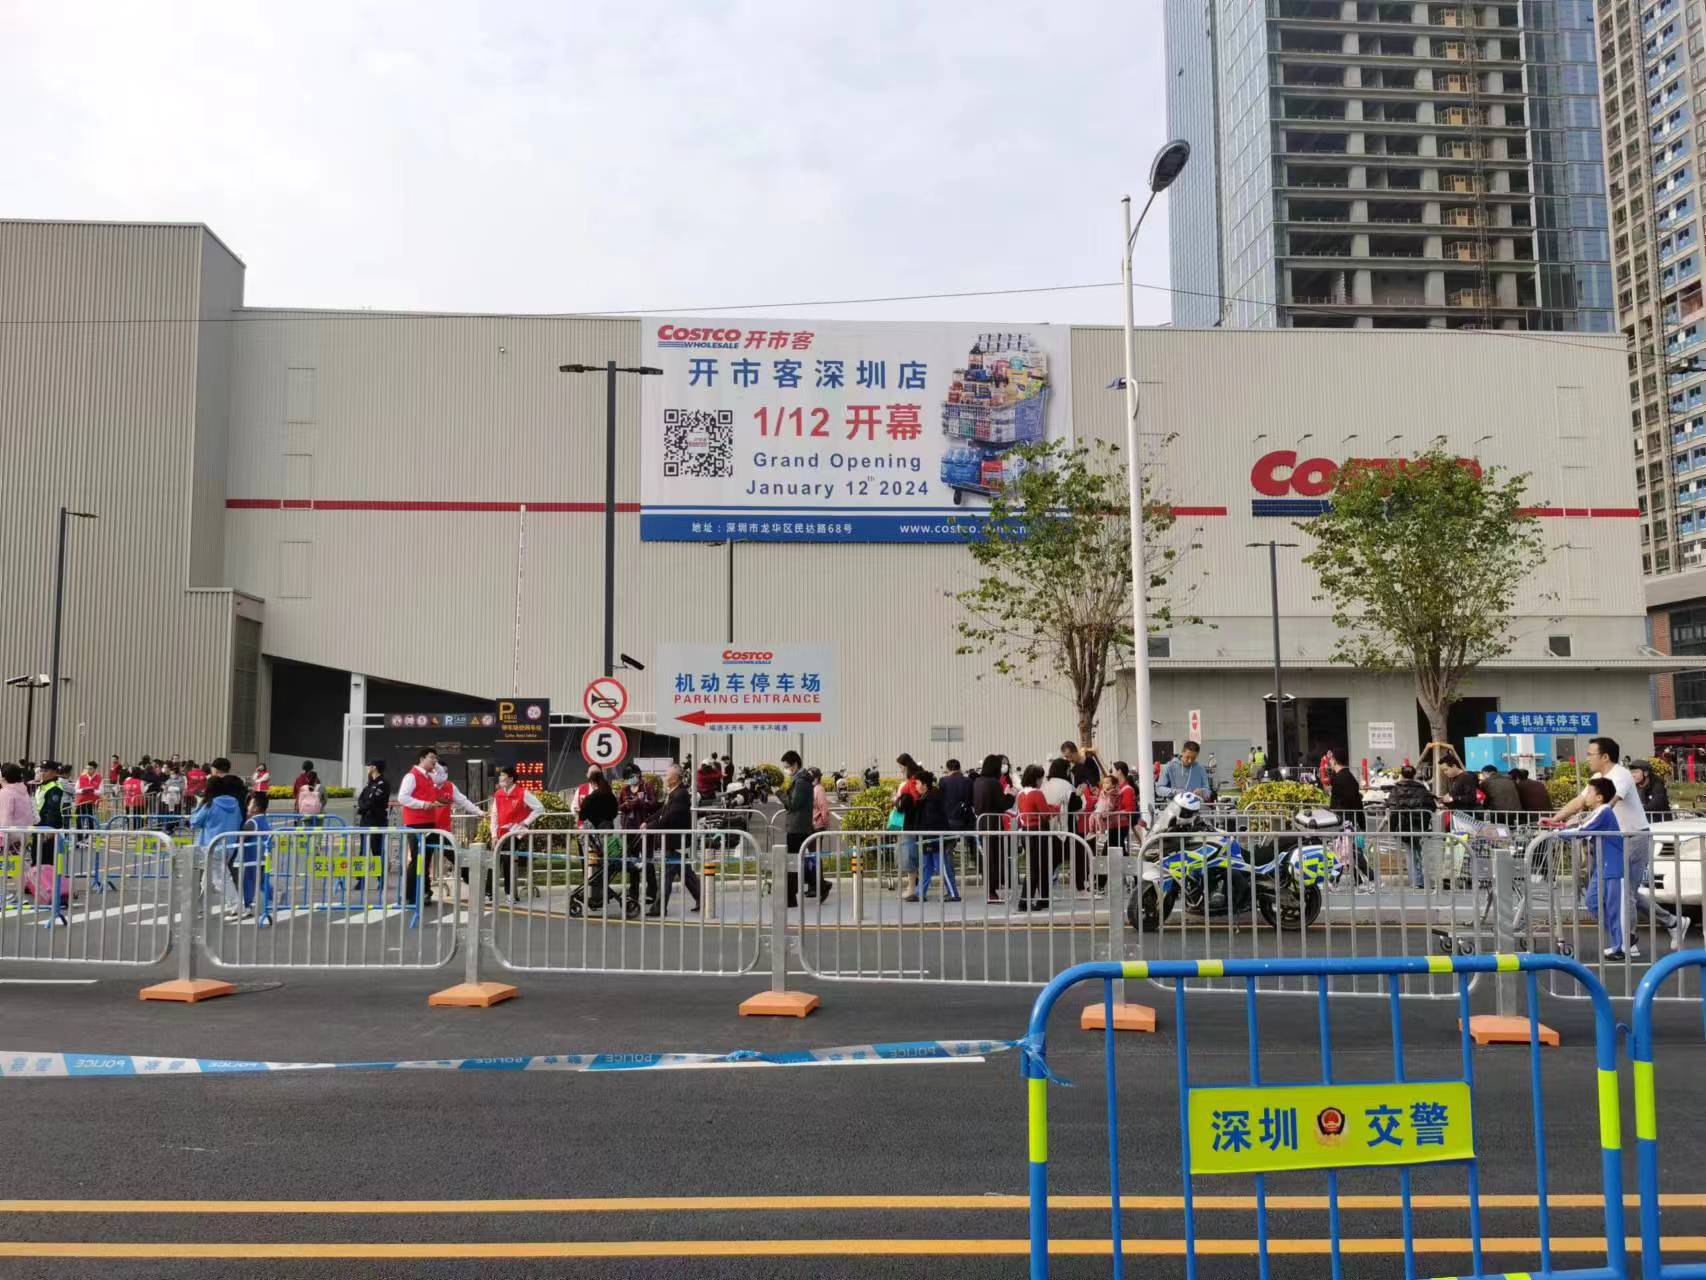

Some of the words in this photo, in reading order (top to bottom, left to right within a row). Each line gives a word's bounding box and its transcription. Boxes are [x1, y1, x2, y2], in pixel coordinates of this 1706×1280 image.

[657, 325, 742, 342] COSTCO
[744, 330, 815, 350] 开市客
[684, 341, 740, 349] WHOLESALE
[688, 357, 927, 390] 开市客深圳店
[754, 406, 830, 437] 1/12
[845, 403, 923, 440] 开幕
[753, 452, 819, 468] Grand
[830, 453, 921, 472] Opening
[746, 480, 834, 499] January
[880, 480, 929, 496] 2024
[722, 650, 773, 660] COSTCO
[674, 672, 821, 693] 机动车停车场
[674, 694, 739, 704] PARKING
[743, 693, 821, 704] ENTRANCE
[499, 701, 515, 721] P
[1508, 714, 1592, 727] 非机动车停车区
[596, 733, 613, 758] 5
[604, 1053, 655, 1064] POLICE
[1210, 1107, 1299, 1153] 深圳
[1364, 1101, 1449, 1148] 交警
